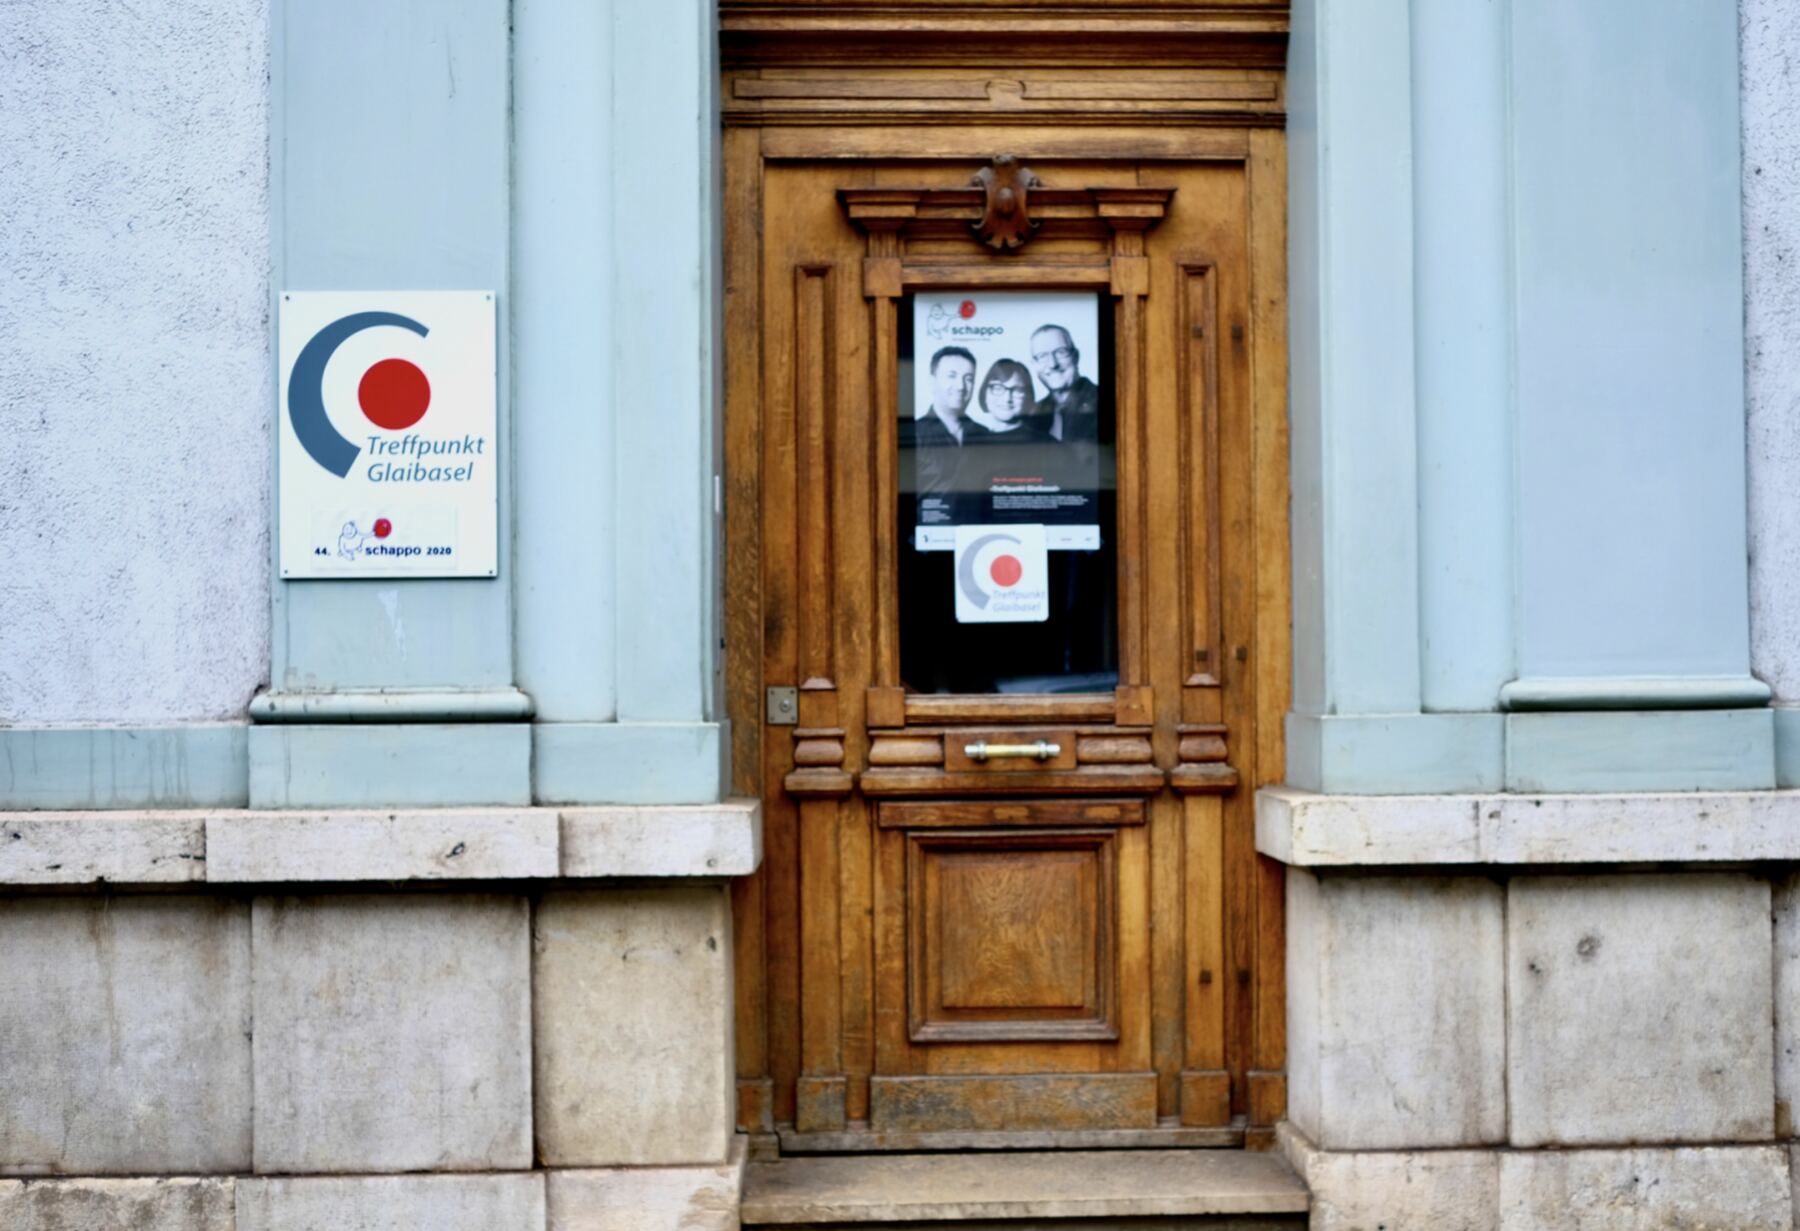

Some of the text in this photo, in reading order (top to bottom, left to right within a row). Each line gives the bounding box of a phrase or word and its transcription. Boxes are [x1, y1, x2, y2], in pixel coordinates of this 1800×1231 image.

[952, 325, 1004, 336] schappo
[367, 435, 484, 458] Treffpunkt
[367, 462, 473, 482] Glaibasel
[314, 545, 452, 557] 44. schappo 2020
